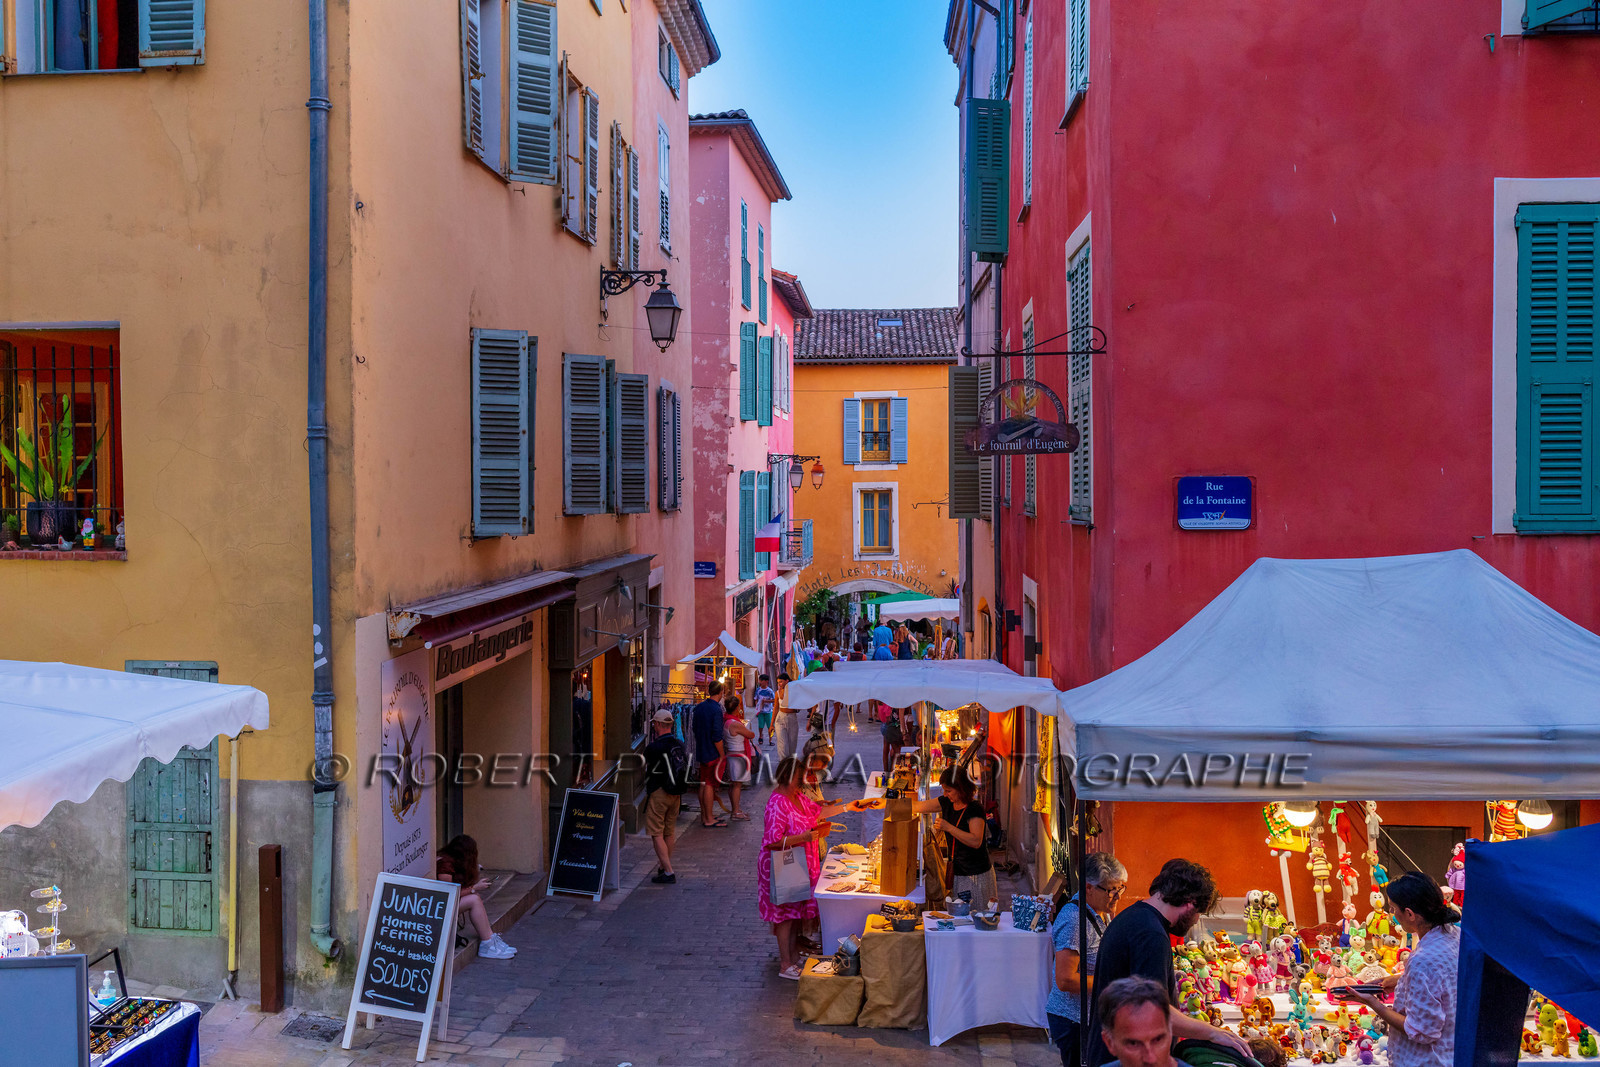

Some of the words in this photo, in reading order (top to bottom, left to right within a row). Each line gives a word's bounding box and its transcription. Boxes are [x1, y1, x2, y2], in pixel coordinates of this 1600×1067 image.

[973, 441, 985, 451] Le
[990, 439, 1021, 450] fournil
[1026, 438, 1070, 452] d'Eugène
[1205, 481, 1224, 491] Rue
[1182, 495, 1194, 505] de
[1196, 495, 1204, 505] la
[1206, 495, 1246, 505] Fontaine
[840, 567, 860, 579] Les
[436, 616, 533, 681] Boulangerie
[394, 836, 412, 857] Depuis
[405, 842, 429, 867] Boulanger
[383, 888, 445, 920] JUNGLE
[382, 915, 433, 935] HOMMES
[380, 926, 433, 946] FEMMES
[374, 941, 397, 954] Mode
[408, 950, 437, 964] baskets
[370, 957, 431, 994] SOLDES
